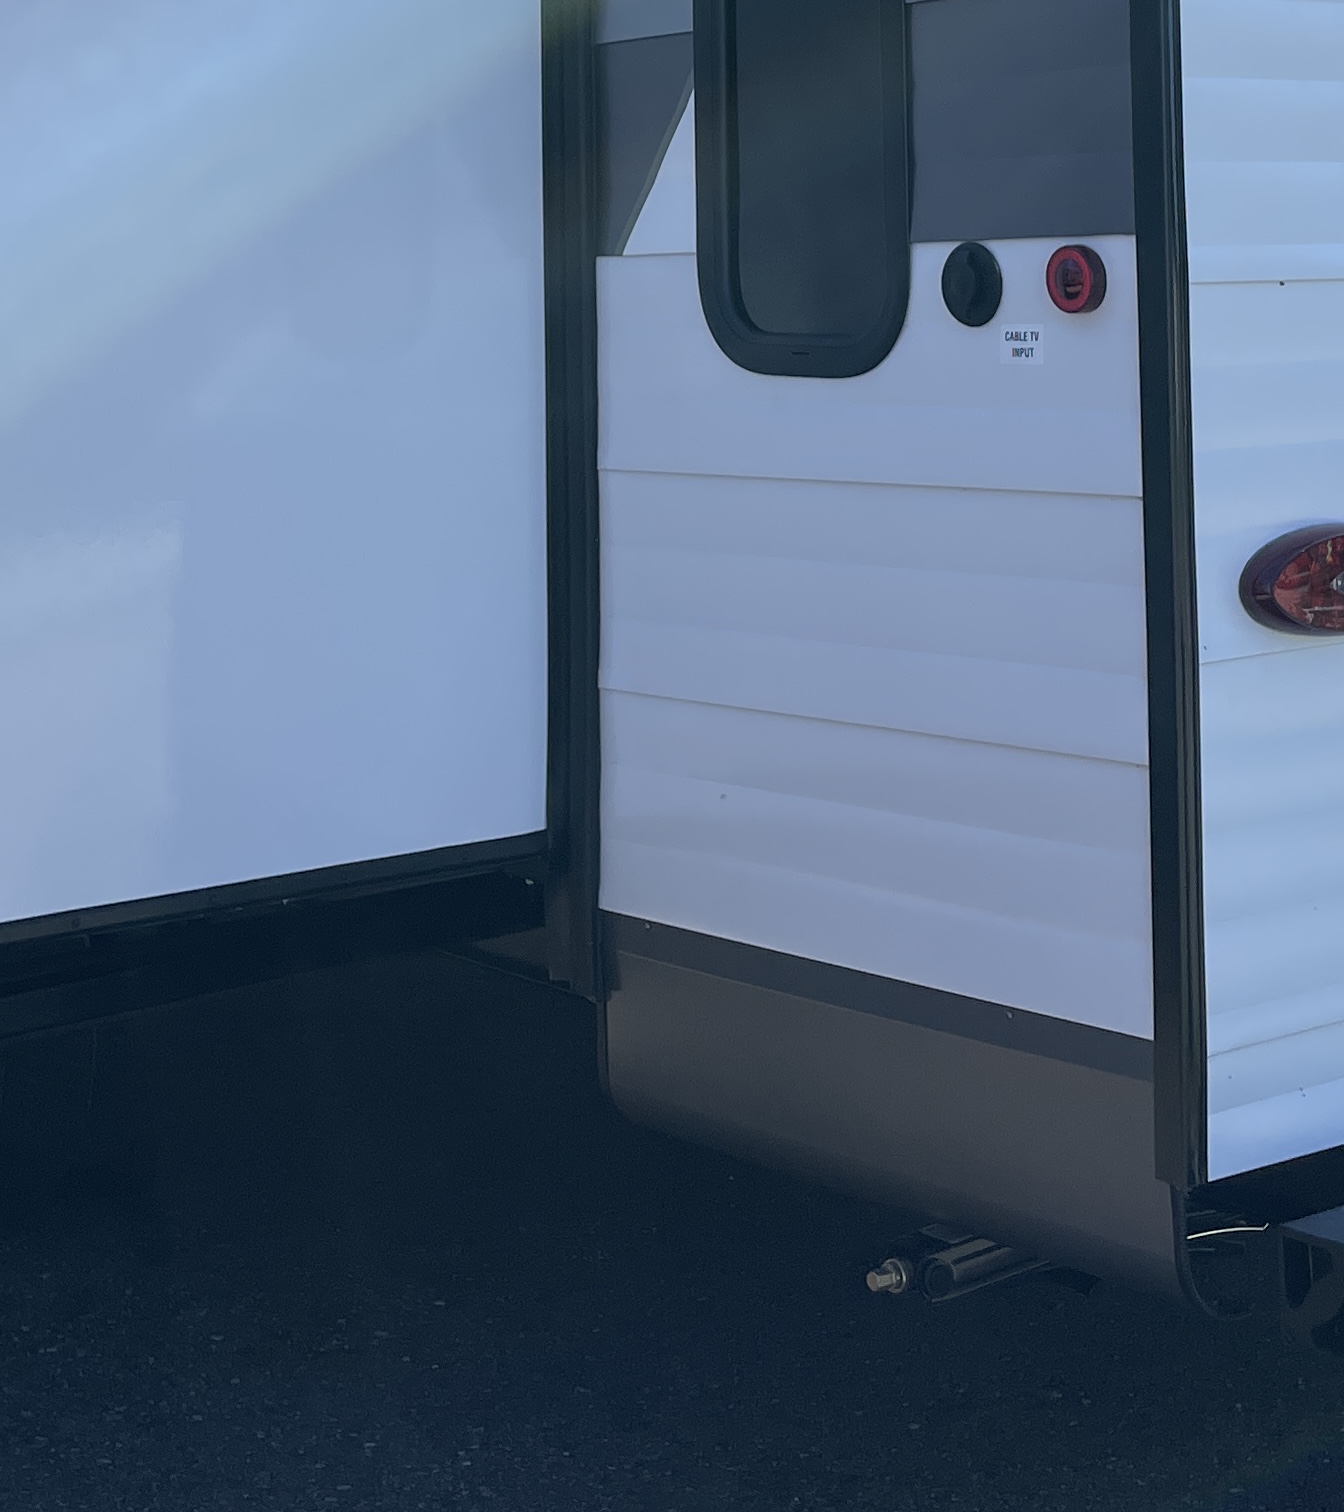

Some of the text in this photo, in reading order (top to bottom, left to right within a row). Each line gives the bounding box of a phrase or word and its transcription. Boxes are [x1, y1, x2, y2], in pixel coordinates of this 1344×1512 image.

[1004, 330, 1040, 342] CABLE TV
[1011, 347, 1035, 358] INPUT
